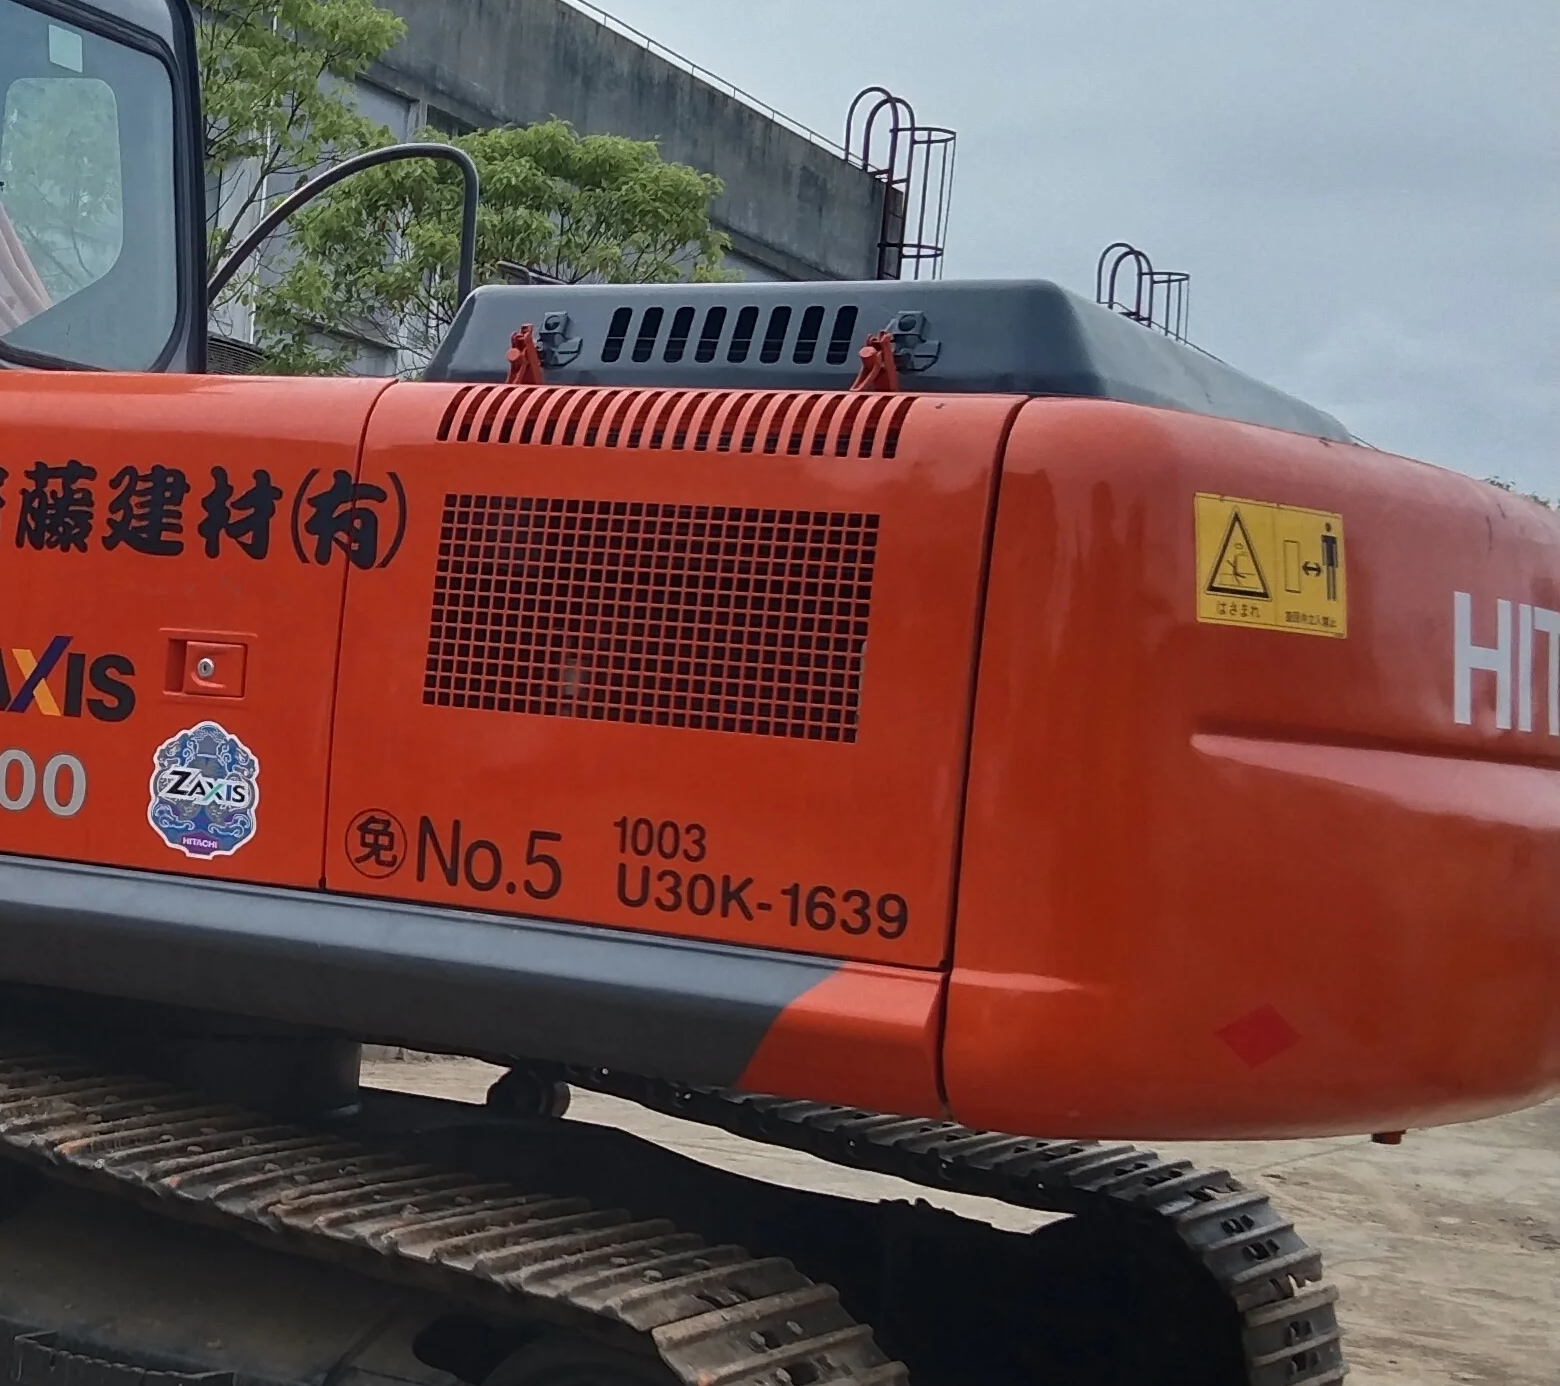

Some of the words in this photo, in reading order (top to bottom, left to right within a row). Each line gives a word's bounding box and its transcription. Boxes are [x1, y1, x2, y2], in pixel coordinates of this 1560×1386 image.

[1216, 600, 1261, 619] はさまれ
[165, 769, 246, 804] ZAXIS
[182, 836, 218, 848] HITACHI
[416, 815, 564, 901] No.5
[614, 815, 708, 863] 1003
[616, 861, 909, 940] U30K-1639
